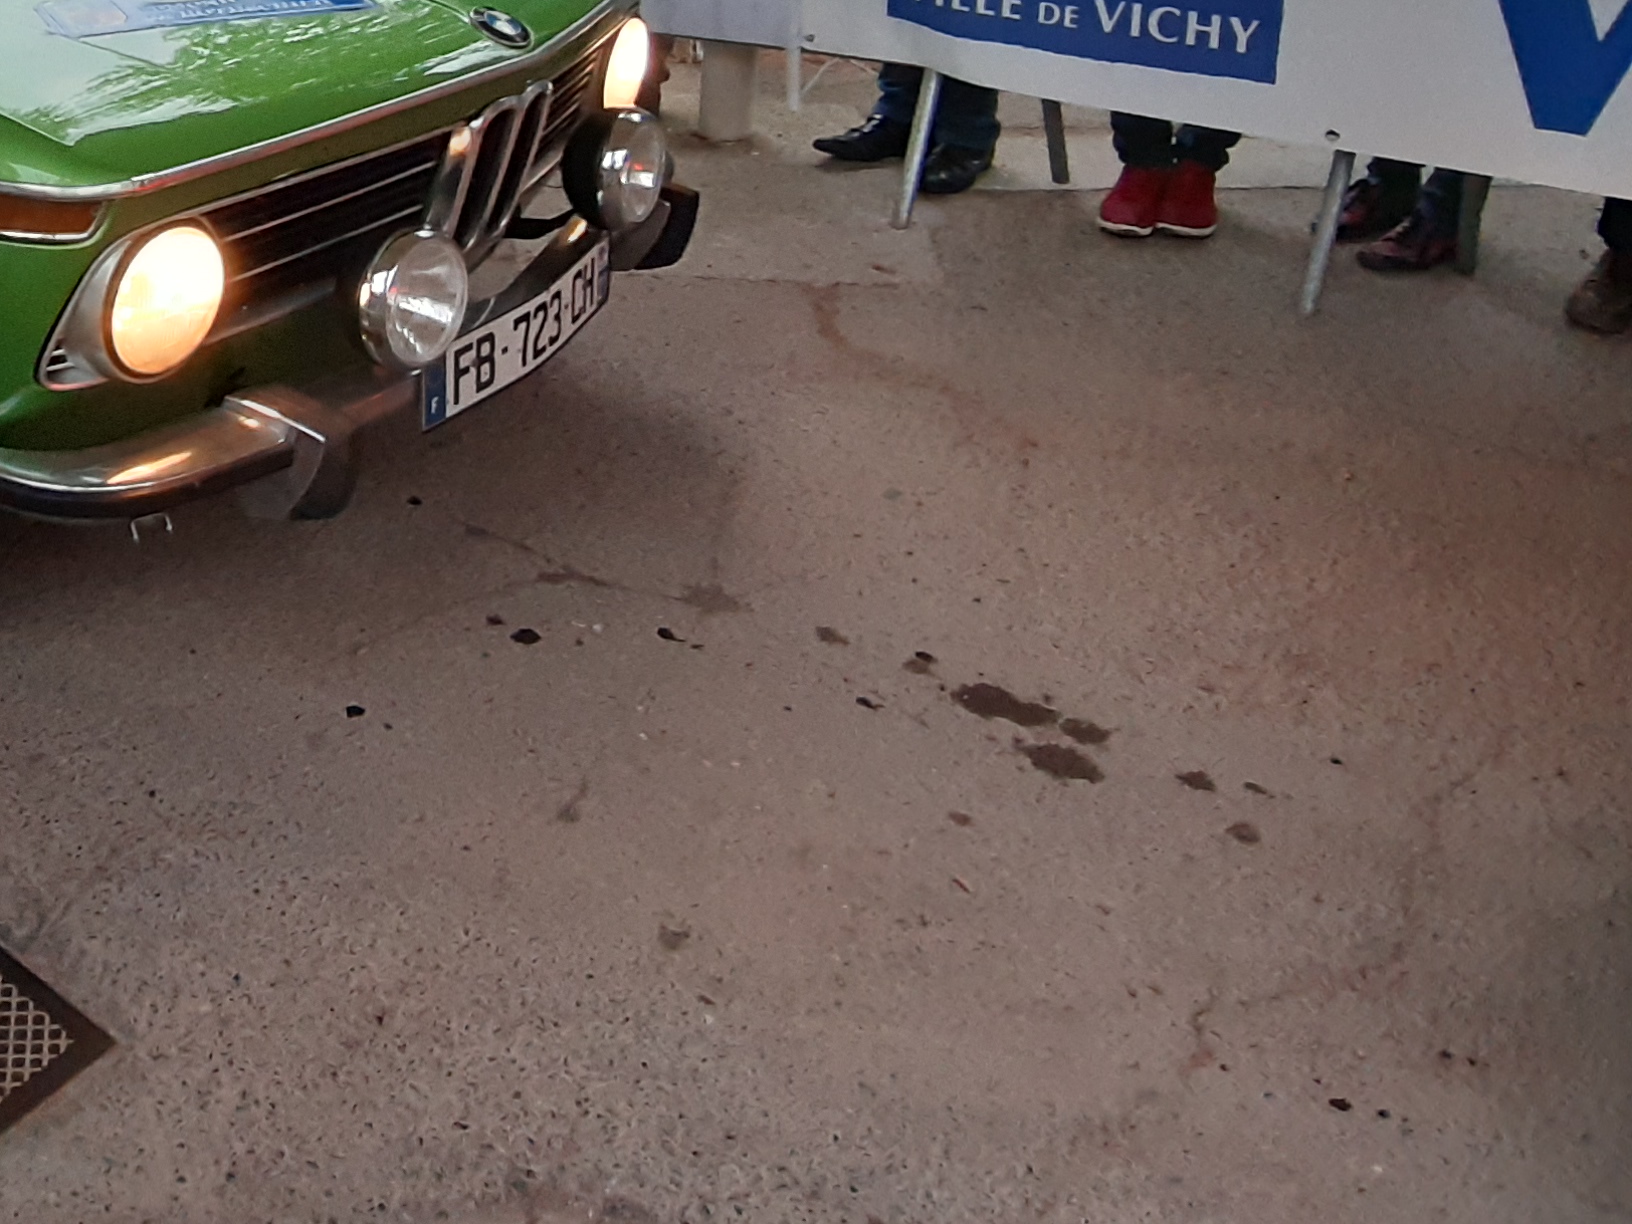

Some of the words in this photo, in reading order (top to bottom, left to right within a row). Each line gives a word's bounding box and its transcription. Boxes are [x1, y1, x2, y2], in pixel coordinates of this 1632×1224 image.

[1037, 1, 1079, 29] DE
[453, 257, 596, 406] FB-723-CH
[430, 395, 439, 414] F
